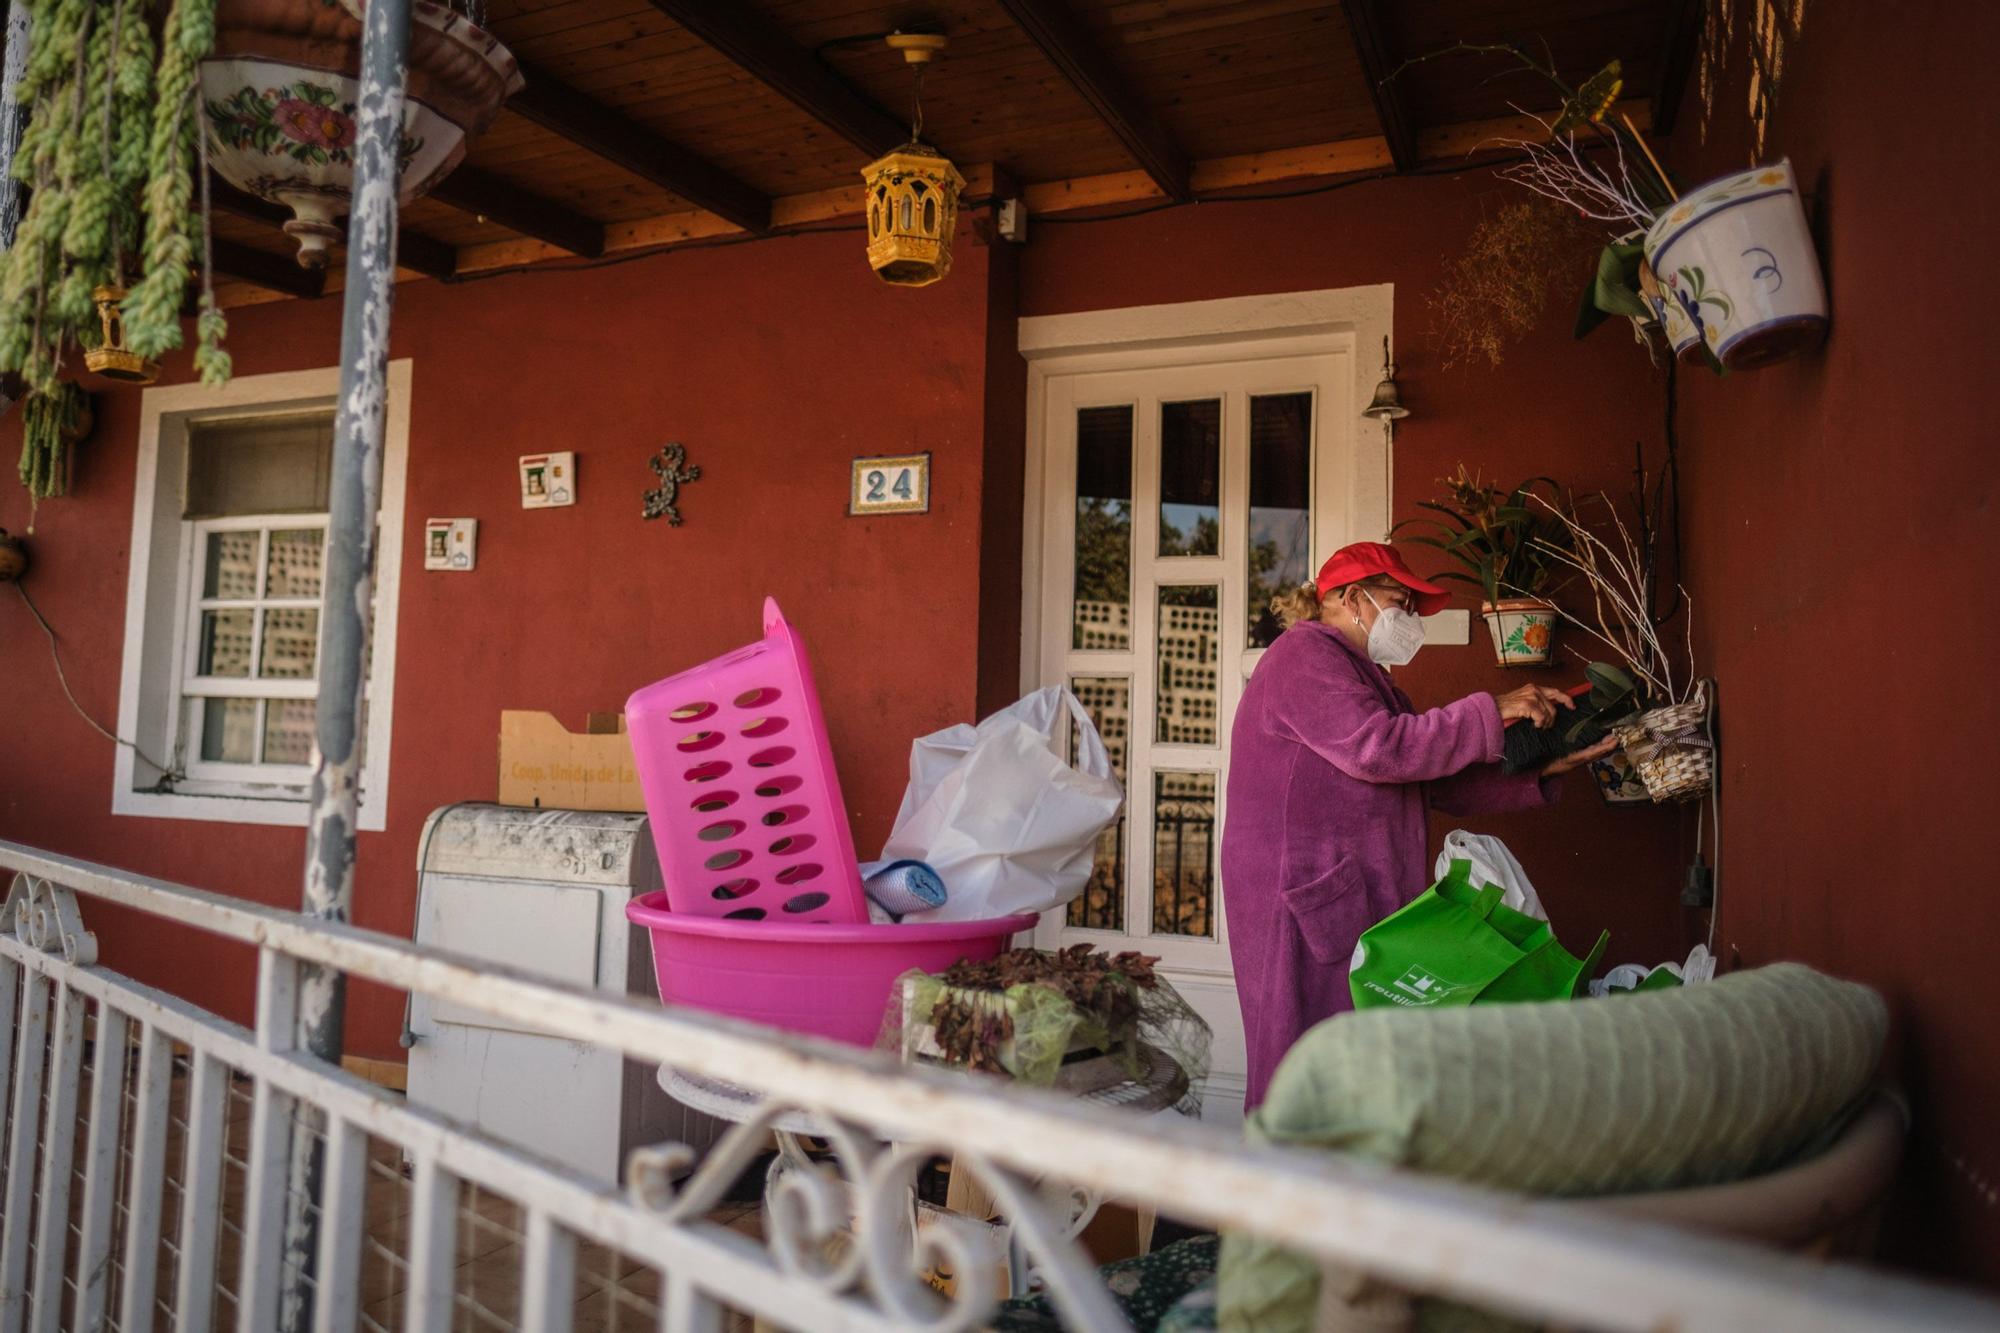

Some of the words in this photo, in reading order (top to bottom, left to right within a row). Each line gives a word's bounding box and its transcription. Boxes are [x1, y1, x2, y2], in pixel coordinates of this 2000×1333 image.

[866, 468, 912, 502] 24
[550, 763, 594, 783] Unidas
[598, 765, 614, 783] de
[618, 766, 634, 784] La
